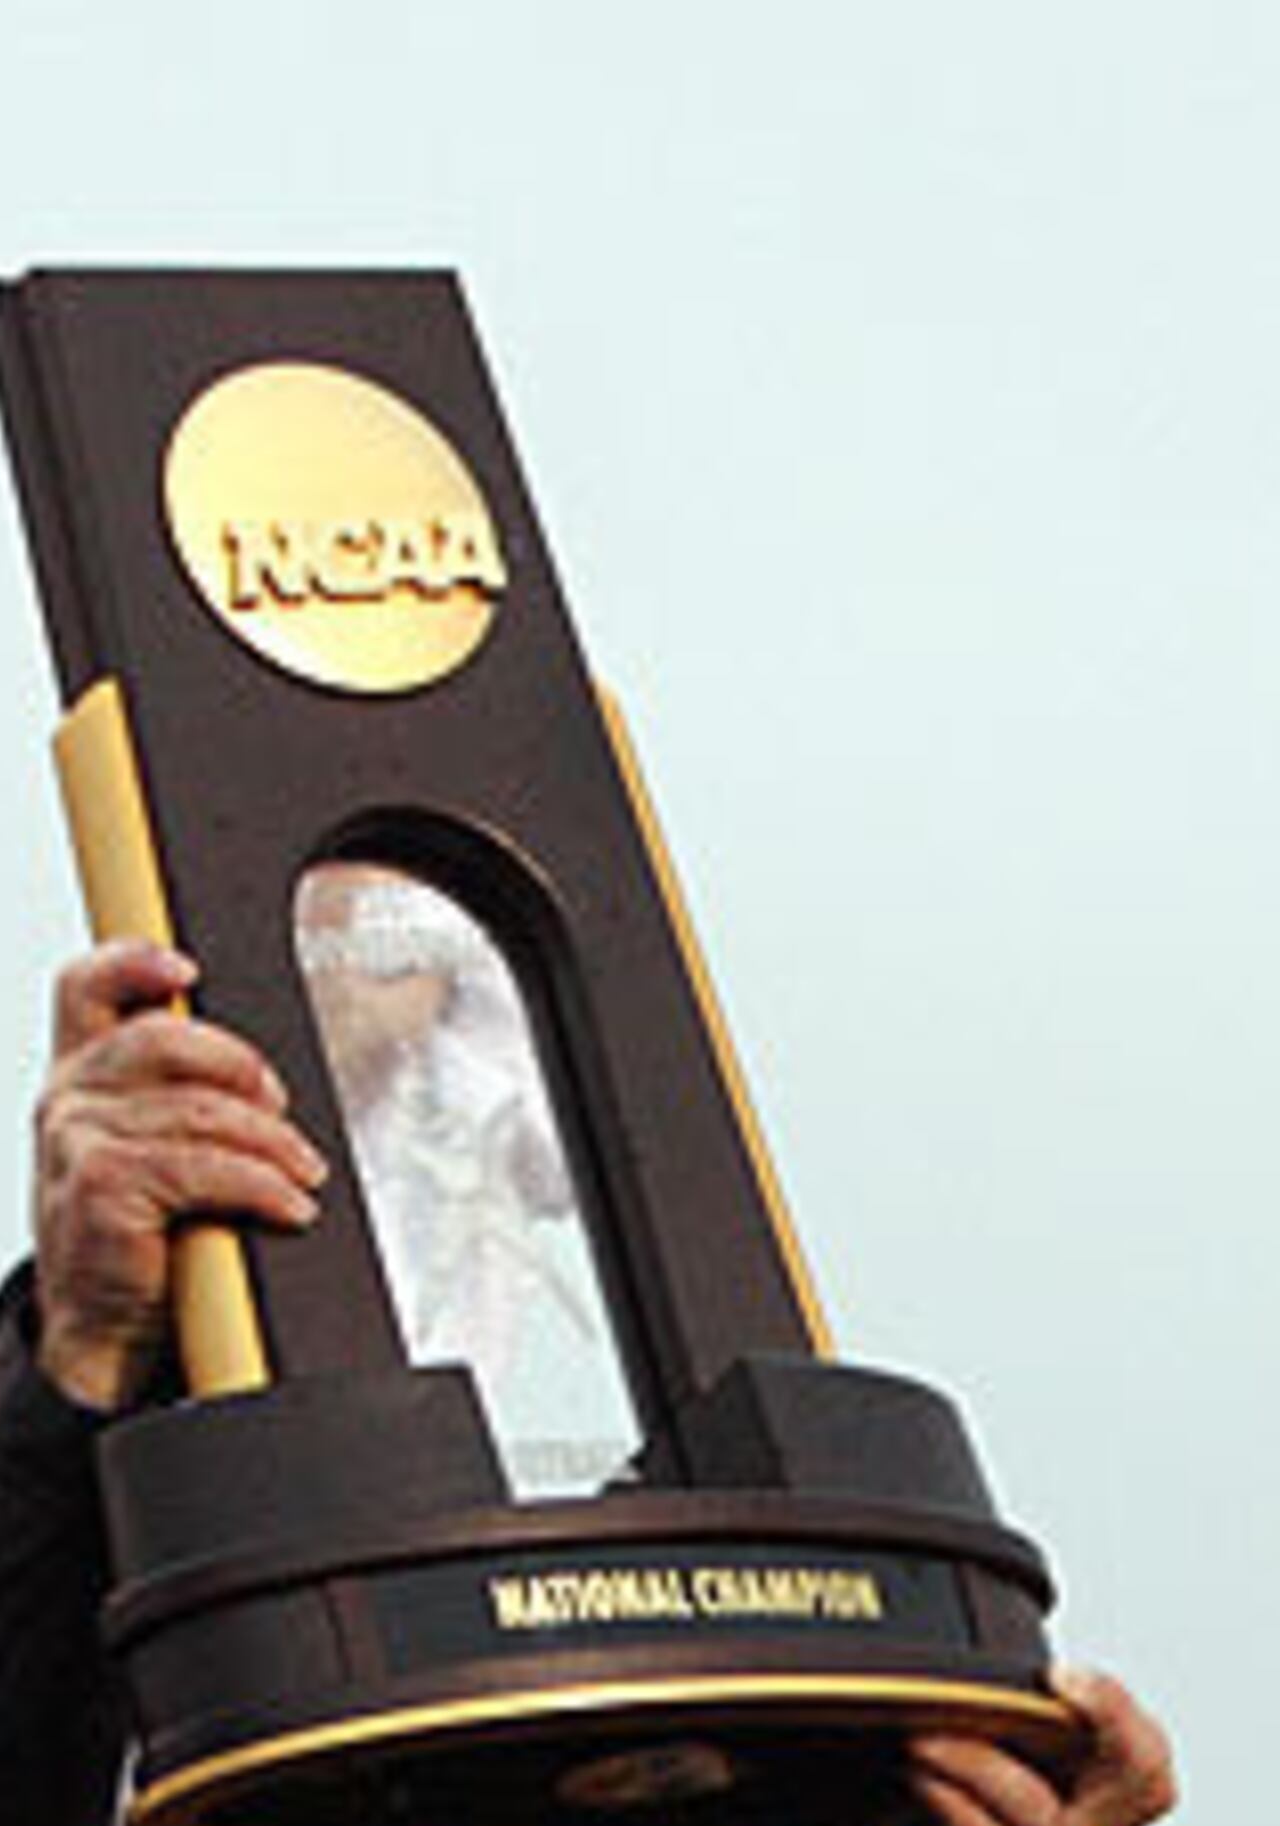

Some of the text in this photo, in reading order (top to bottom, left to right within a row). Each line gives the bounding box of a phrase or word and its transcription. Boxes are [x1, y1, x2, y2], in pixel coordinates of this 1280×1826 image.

[220, 516, 507, 612] NCAA
[488, 1567, 883, 1629] NATIONAL CHAMPION
